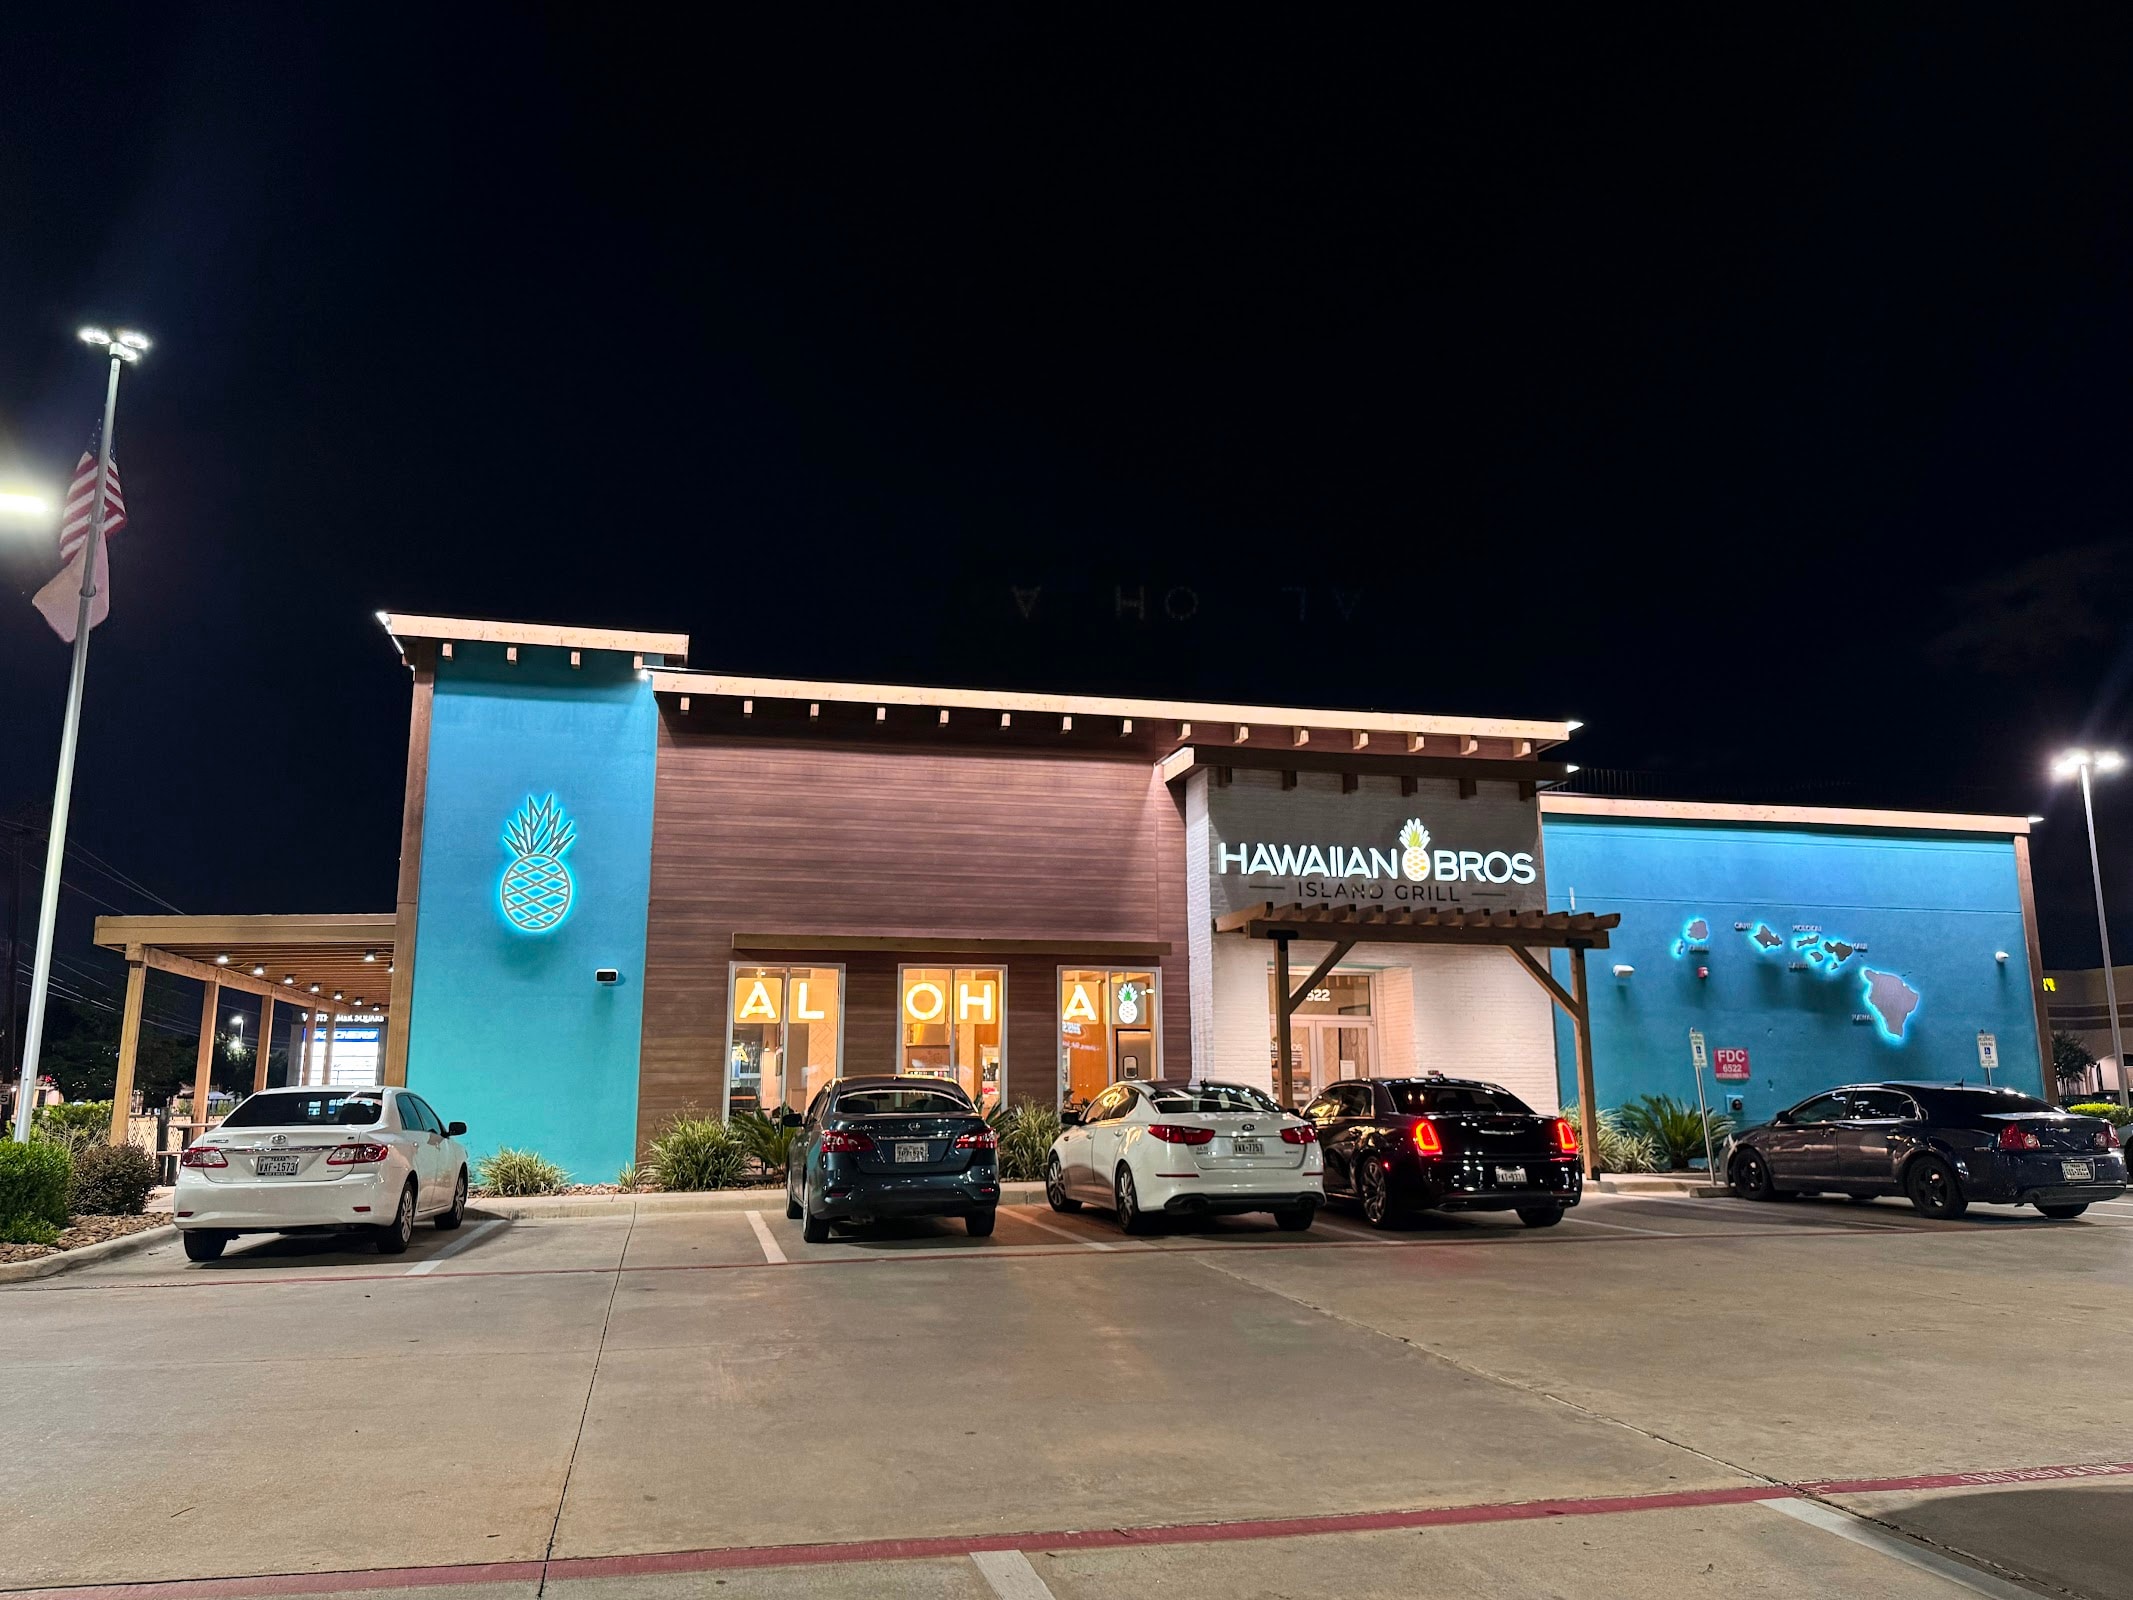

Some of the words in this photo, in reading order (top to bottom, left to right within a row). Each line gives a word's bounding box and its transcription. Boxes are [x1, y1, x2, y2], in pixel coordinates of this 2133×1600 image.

[1217, 842, 1398, 880] HAWAIIAN
[1433, 850, 1537, 885] BROS
[1298, 881, 1384, 900] ISLAND
[1394, 885, 1460, 902] GRILL
[1306, 988, 1331, 1001] 522
[1718, 1050, 1745, 1063] FDC
[1723, 1064, 1742, 1073] 6522
